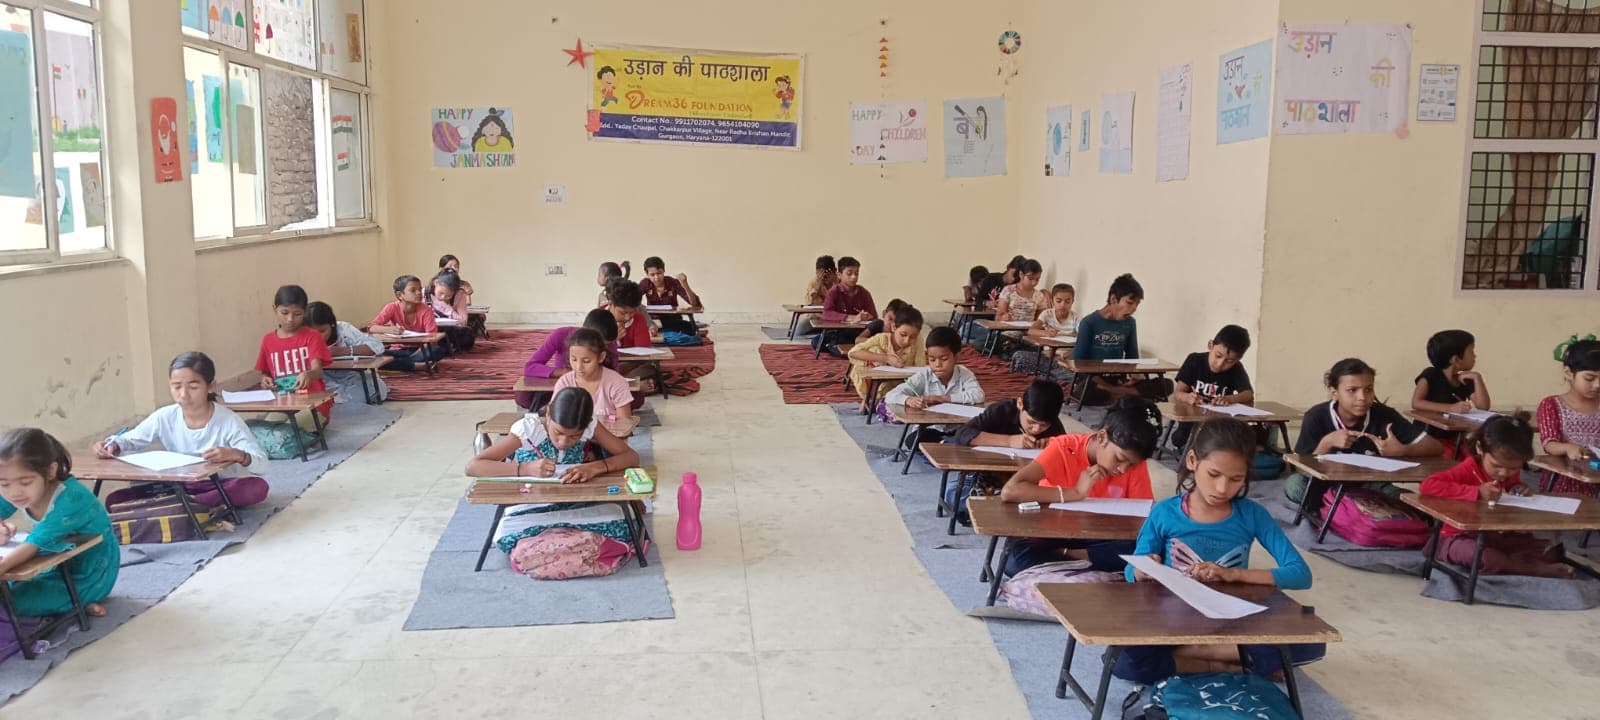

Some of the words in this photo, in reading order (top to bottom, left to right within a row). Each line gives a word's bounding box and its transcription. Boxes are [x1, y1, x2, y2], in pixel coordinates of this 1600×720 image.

[1288, 31, 1337, 59] उड़ान
[623, 58, 668, 80] उड़ान
[672, 55, 695, 78] की
[700, 62, 771, 82] पाठशाला
[1369, 57, 1397, 88] की
[690, 100, 753, 113] FOUNDATION
[1285, 99, 1360, 123] पाठशाला
[438, 108, 474, 120] HAPPY
[852, 109, 882, 121] HAPPY
[881, 128, 927, 141] CHILDREN
[856, 145, 876, 156] DAY
[450, 153, 515, 168] JANMASHTAM
